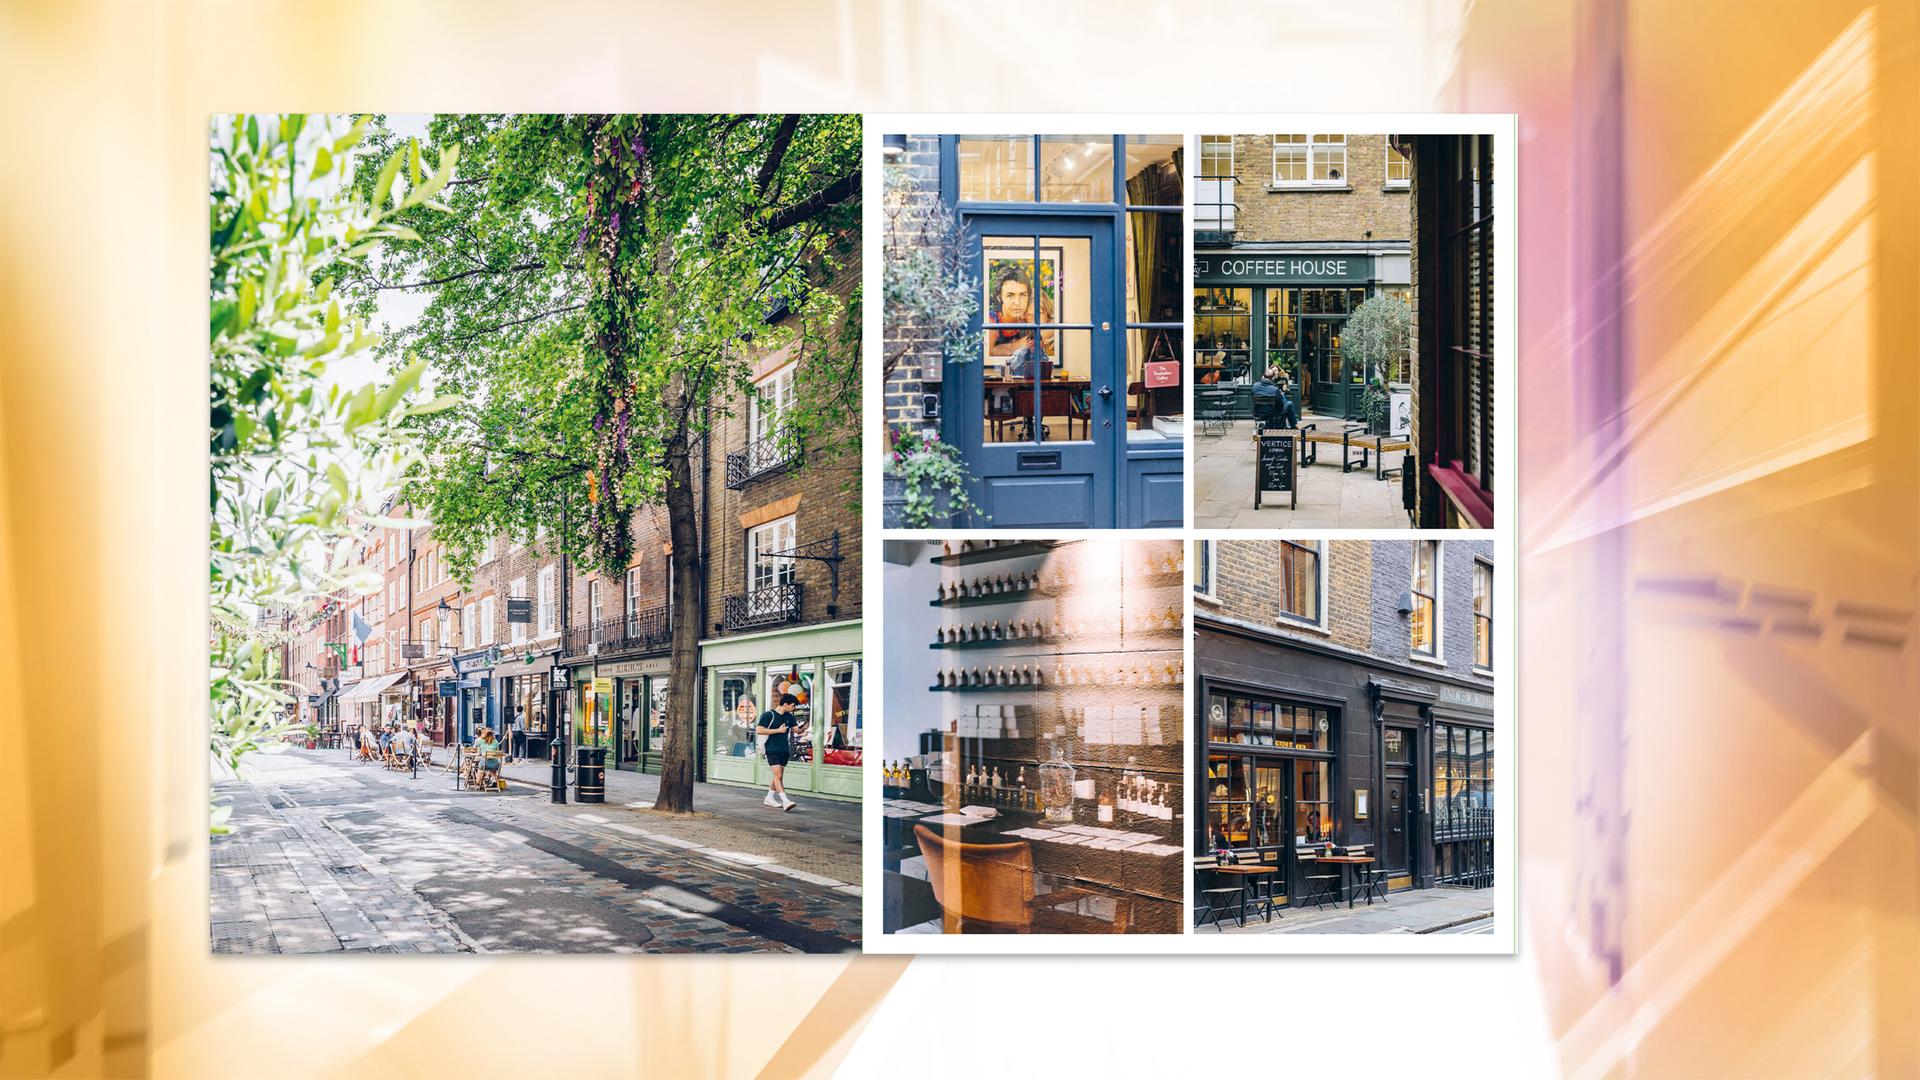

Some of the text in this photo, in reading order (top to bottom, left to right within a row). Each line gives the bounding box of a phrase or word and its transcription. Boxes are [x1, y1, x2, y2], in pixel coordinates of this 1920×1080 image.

[1221, 260, 1347, 276] COFFEE HOUSE
[1261, 440, 1292, 448] VERTICE
